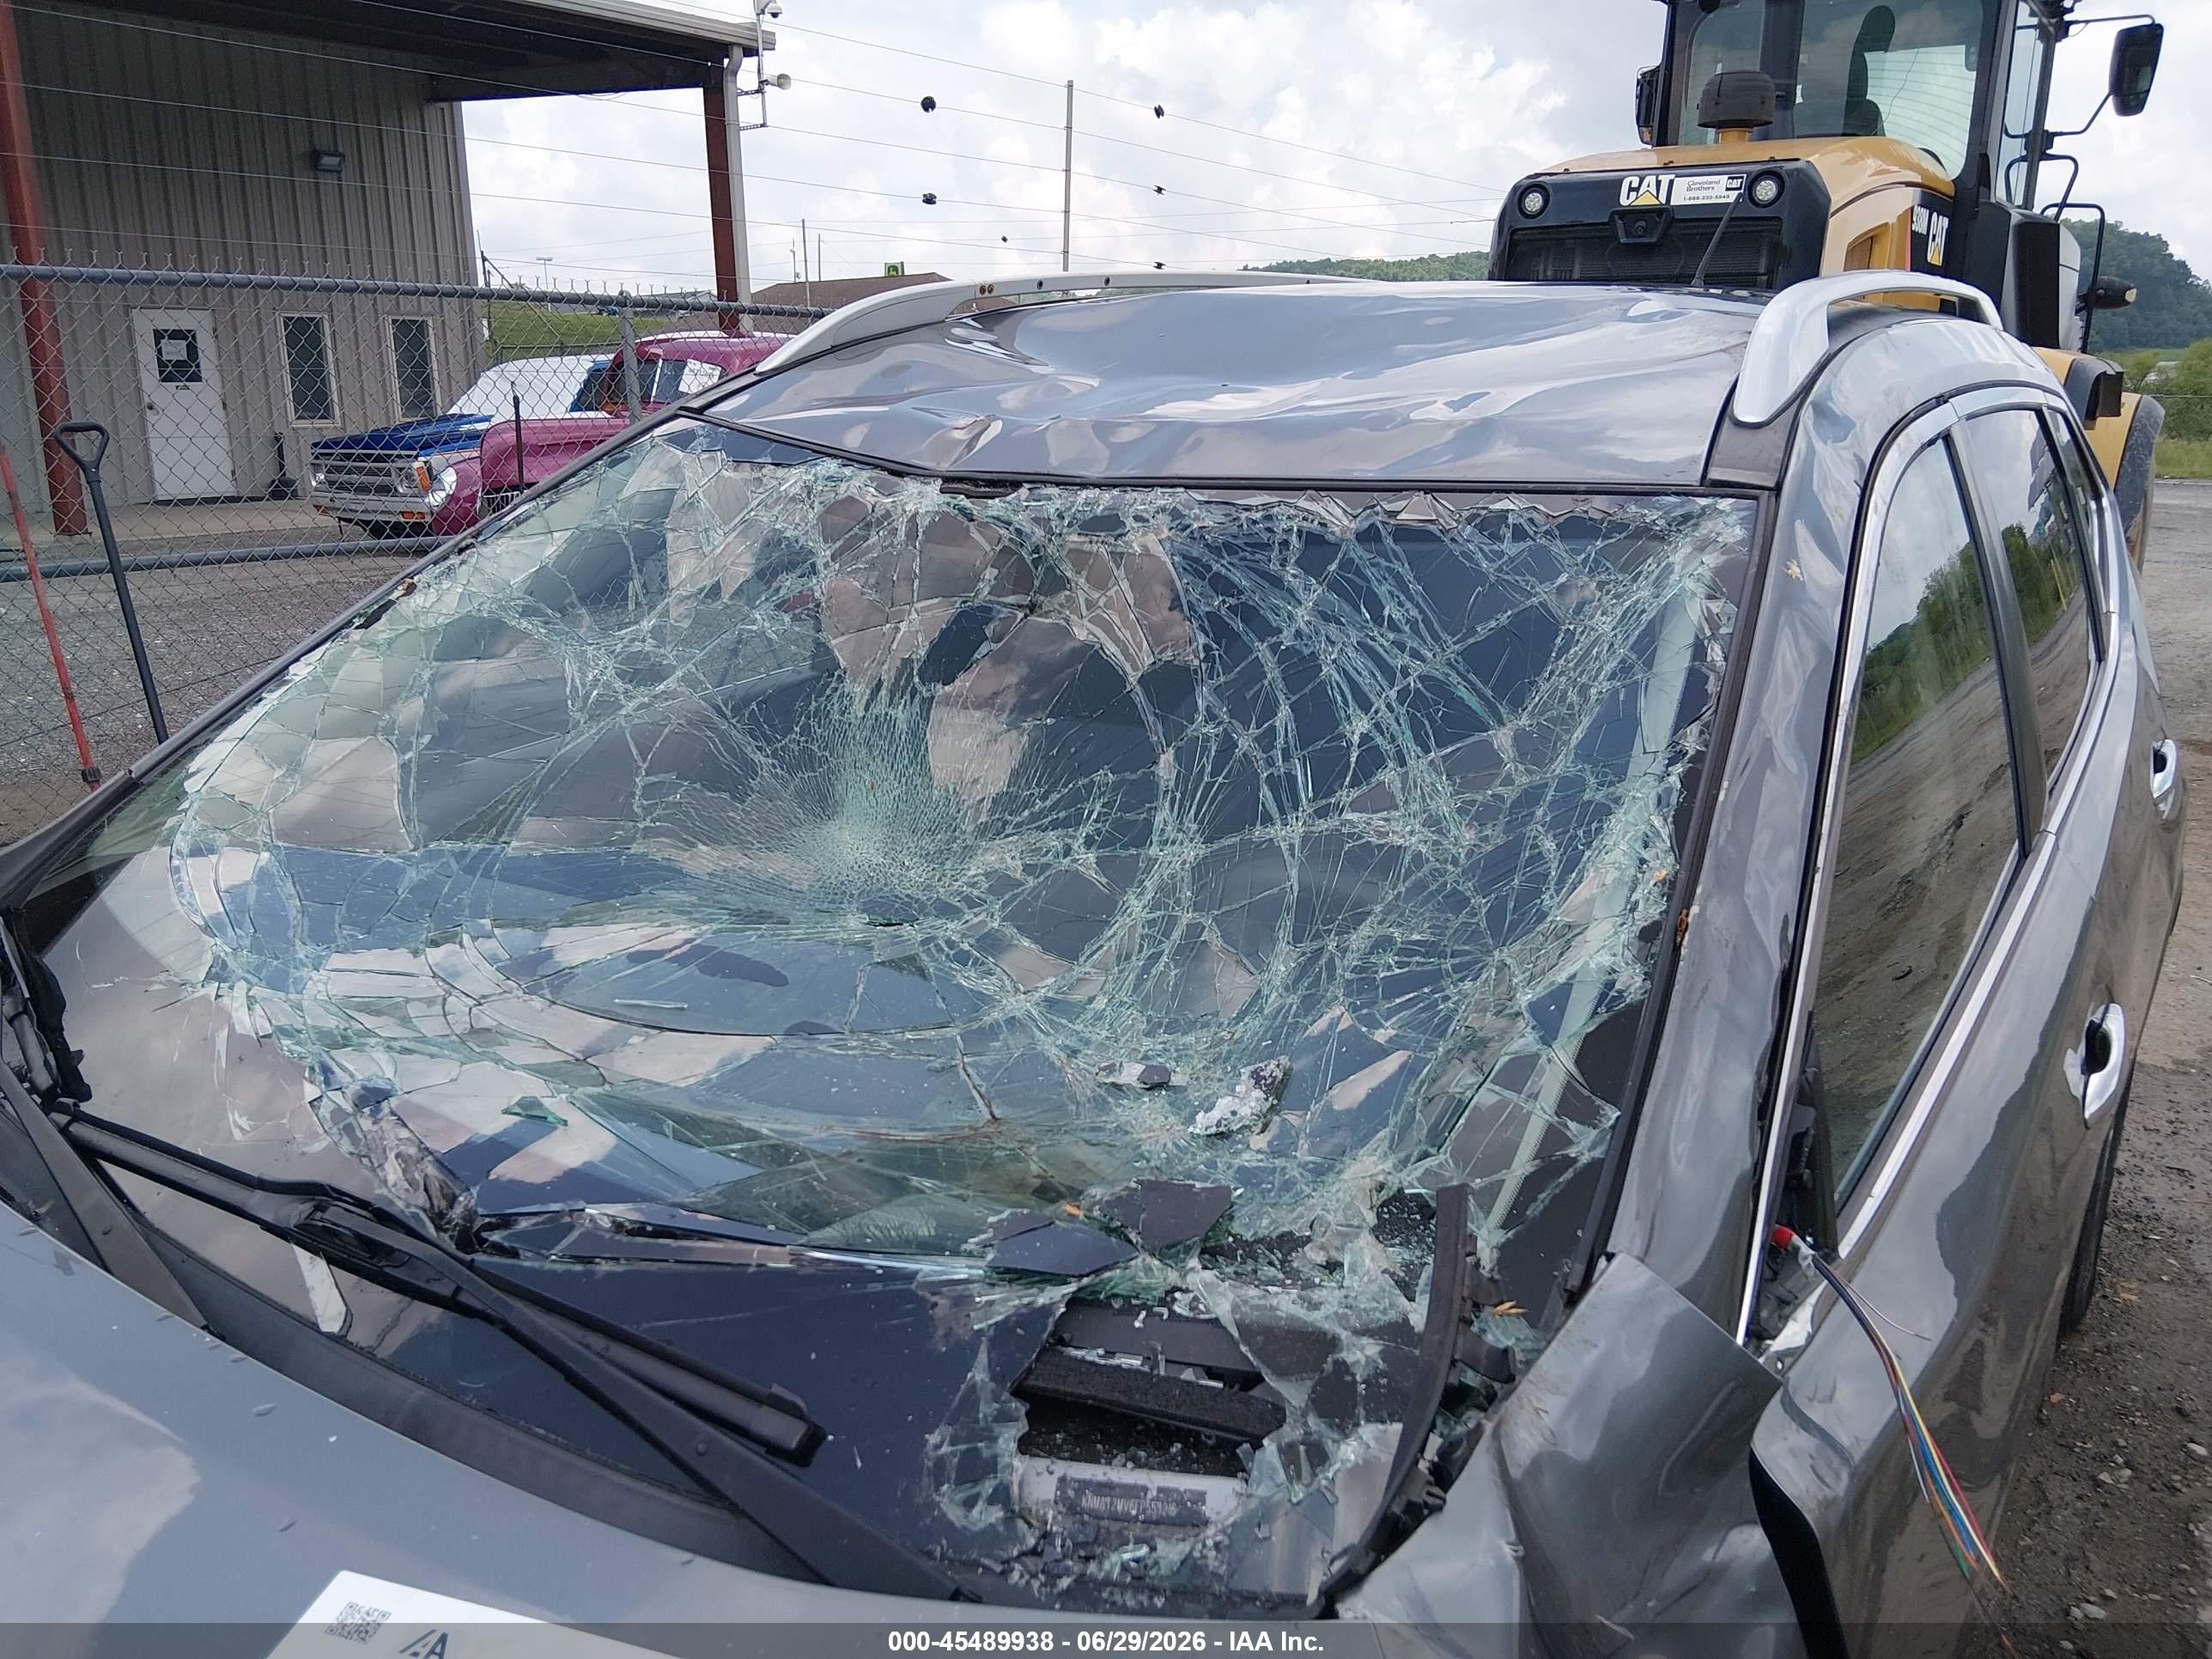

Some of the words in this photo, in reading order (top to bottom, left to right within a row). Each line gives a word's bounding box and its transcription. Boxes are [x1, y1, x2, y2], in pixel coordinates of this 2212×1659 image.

[1620, 174, 1675, 206] CAT
[1726, 178, 1743, 189] CAT
[1927, 211, 1949, 266] CAT
